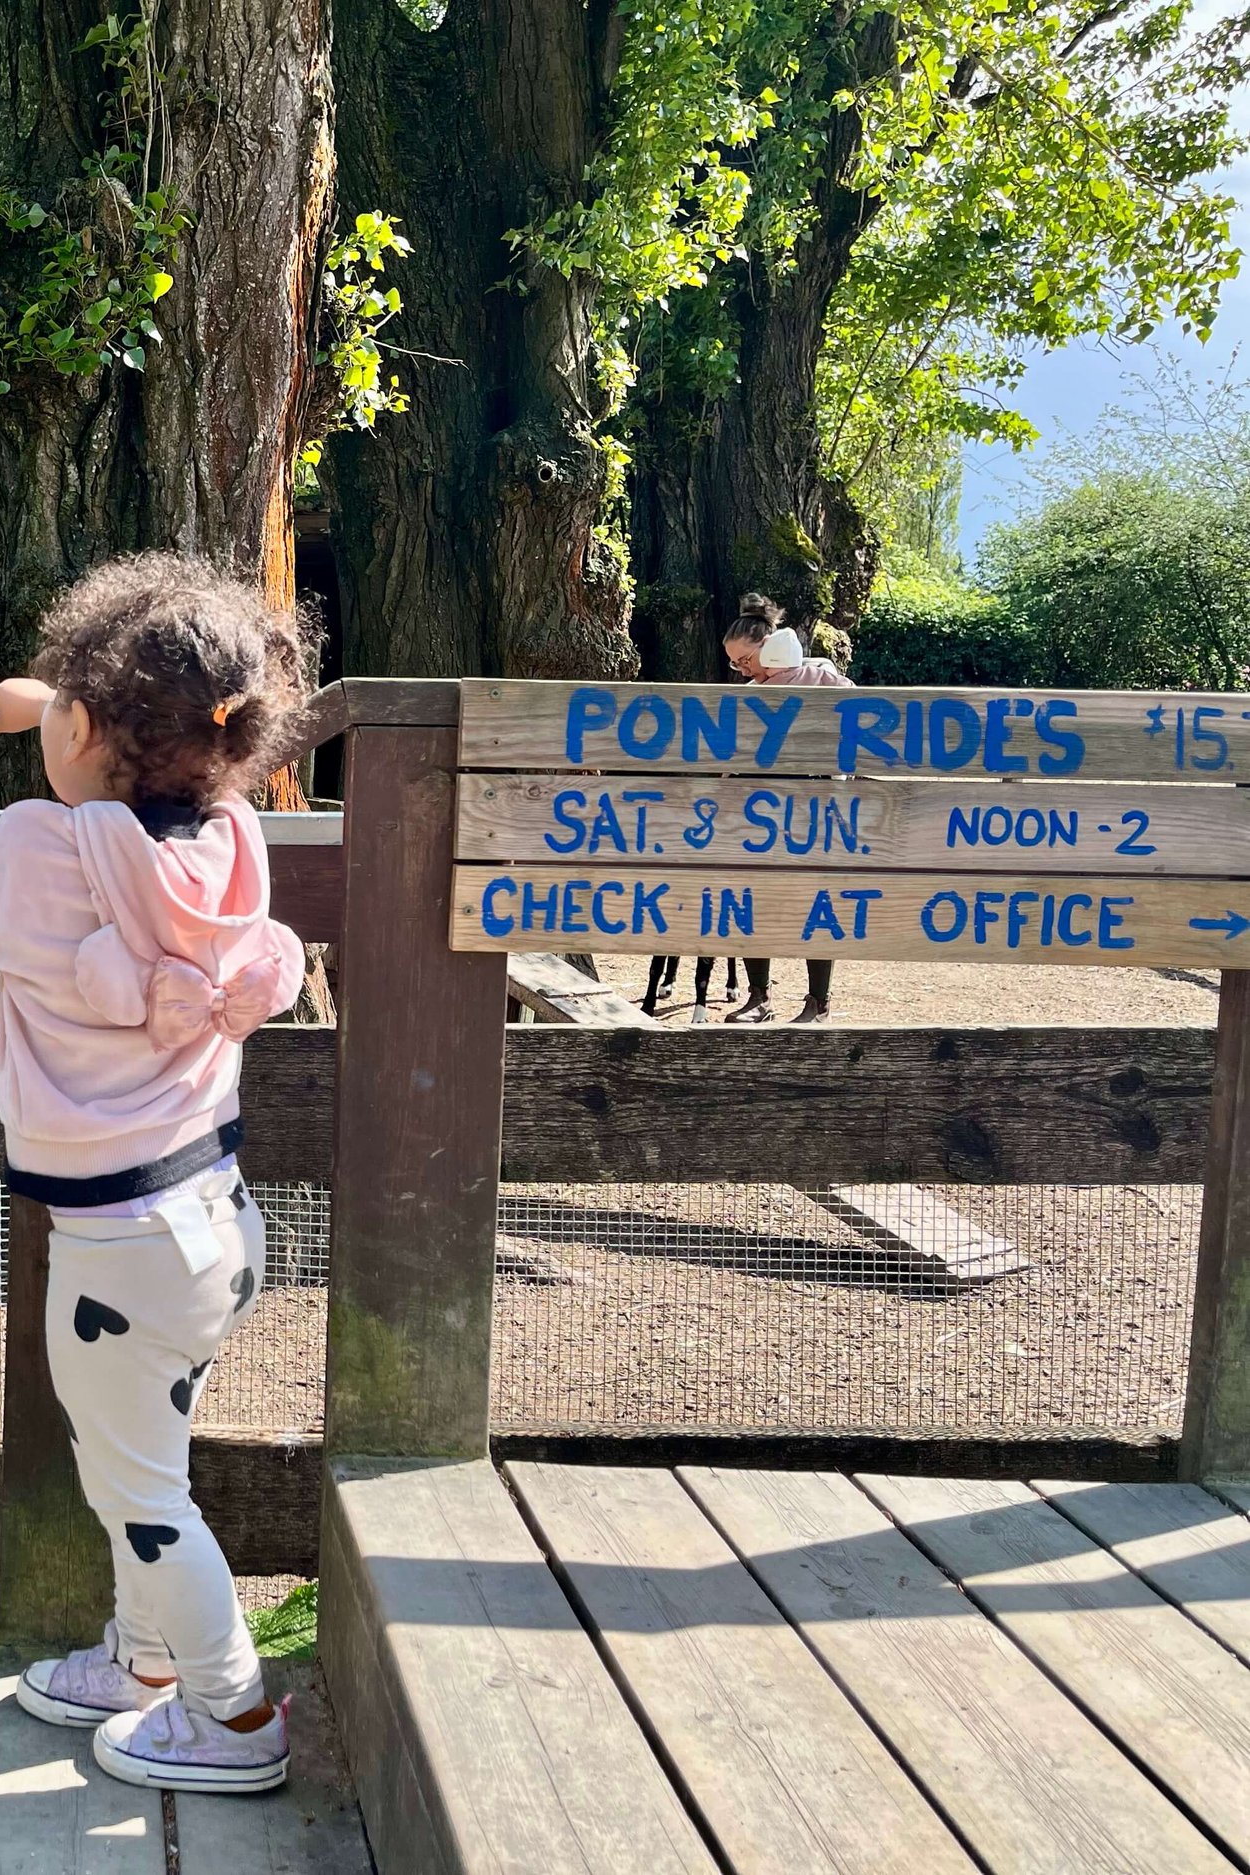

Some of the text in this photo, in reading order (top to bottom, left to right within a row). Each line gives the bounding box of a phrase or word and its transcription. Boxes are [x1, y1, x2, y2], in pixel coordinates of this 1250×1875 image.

[565, 687, 803, 768] PONY
[543, 789, 664, 854] SAT.
[682, 799, 717, 850] &
[742, 790, 870, 855] SUN.
[802, 889, 882, 941] AT
[920, 891, 1134, 949] OFFICE
